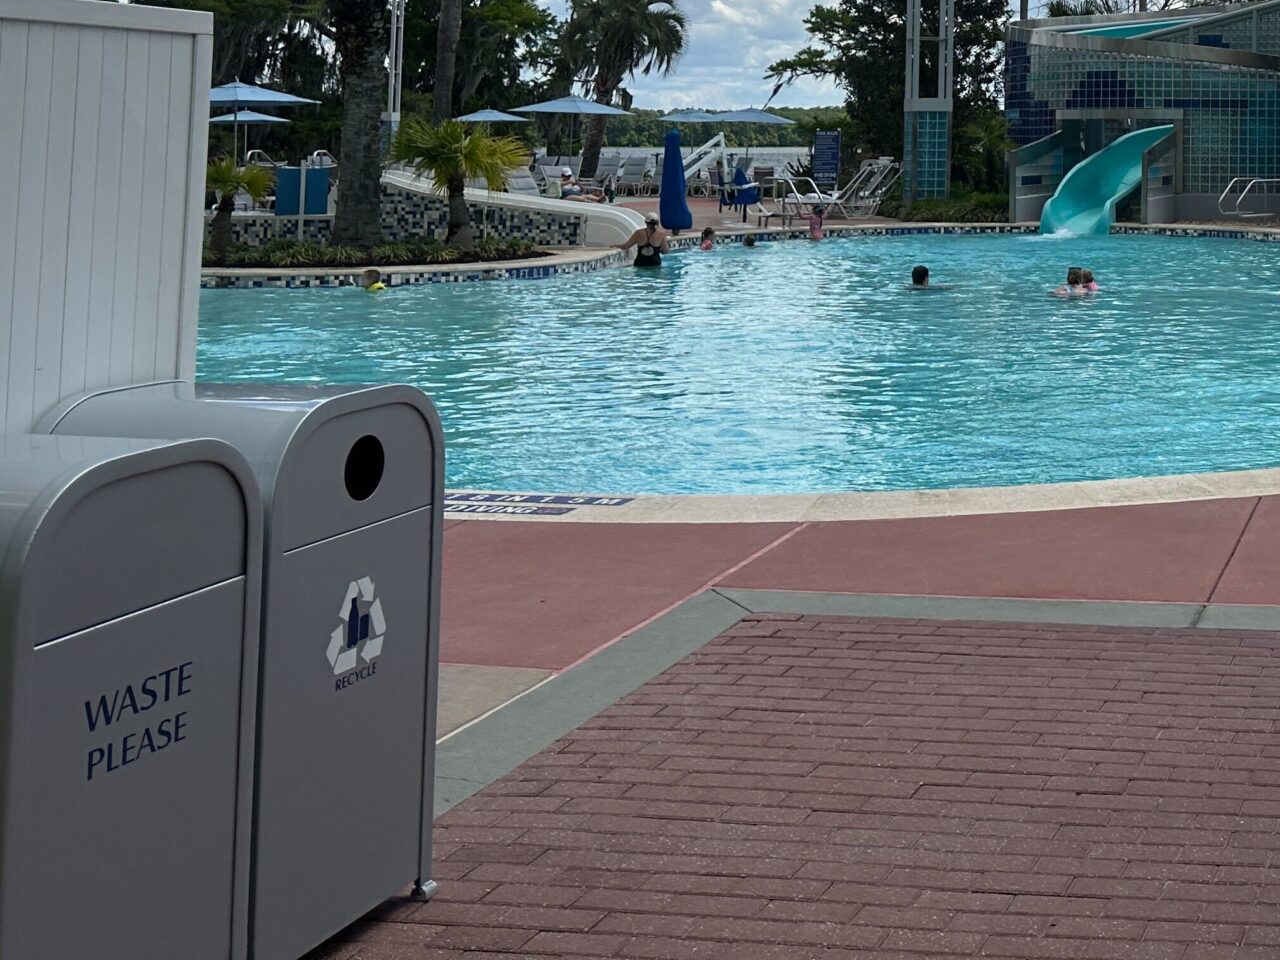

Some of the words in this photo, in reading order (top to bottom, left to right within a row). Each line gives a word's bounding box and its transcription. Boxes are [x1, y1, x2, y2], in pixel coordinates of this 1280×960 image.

[445, 504, 539, 515] DIVING
[495, 495, 527, 503] IN
[334, 661, 378, 692] RECYCLE
[84, 661, 193, 732] WASTE
[86, 711, 188, 781] PLEASE
